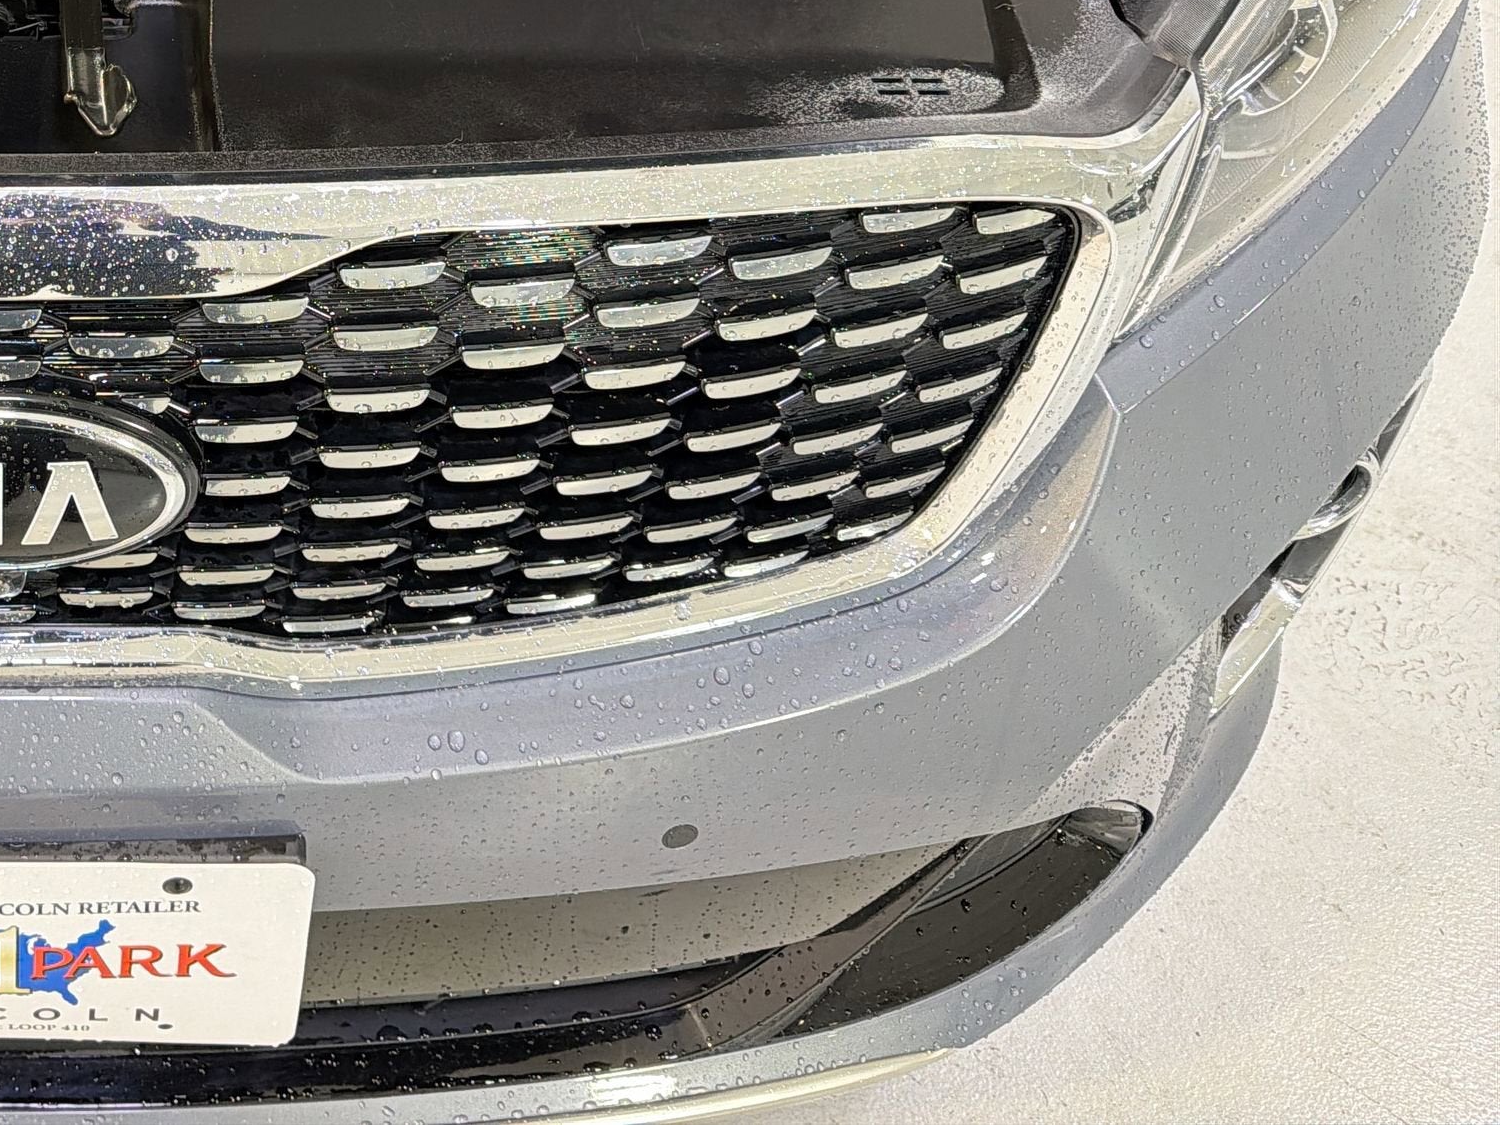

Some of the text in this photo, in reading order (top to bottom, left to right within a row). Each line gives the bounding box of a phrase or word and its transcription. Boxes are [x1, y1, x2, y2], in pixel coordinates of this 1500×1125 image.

[78, 900, 202, 915] RETAILER
[31, 944, 238, 979] PARK
[8, 1023, 57, 1031] LOOP
[61, 1024, 90, 1032] 410
